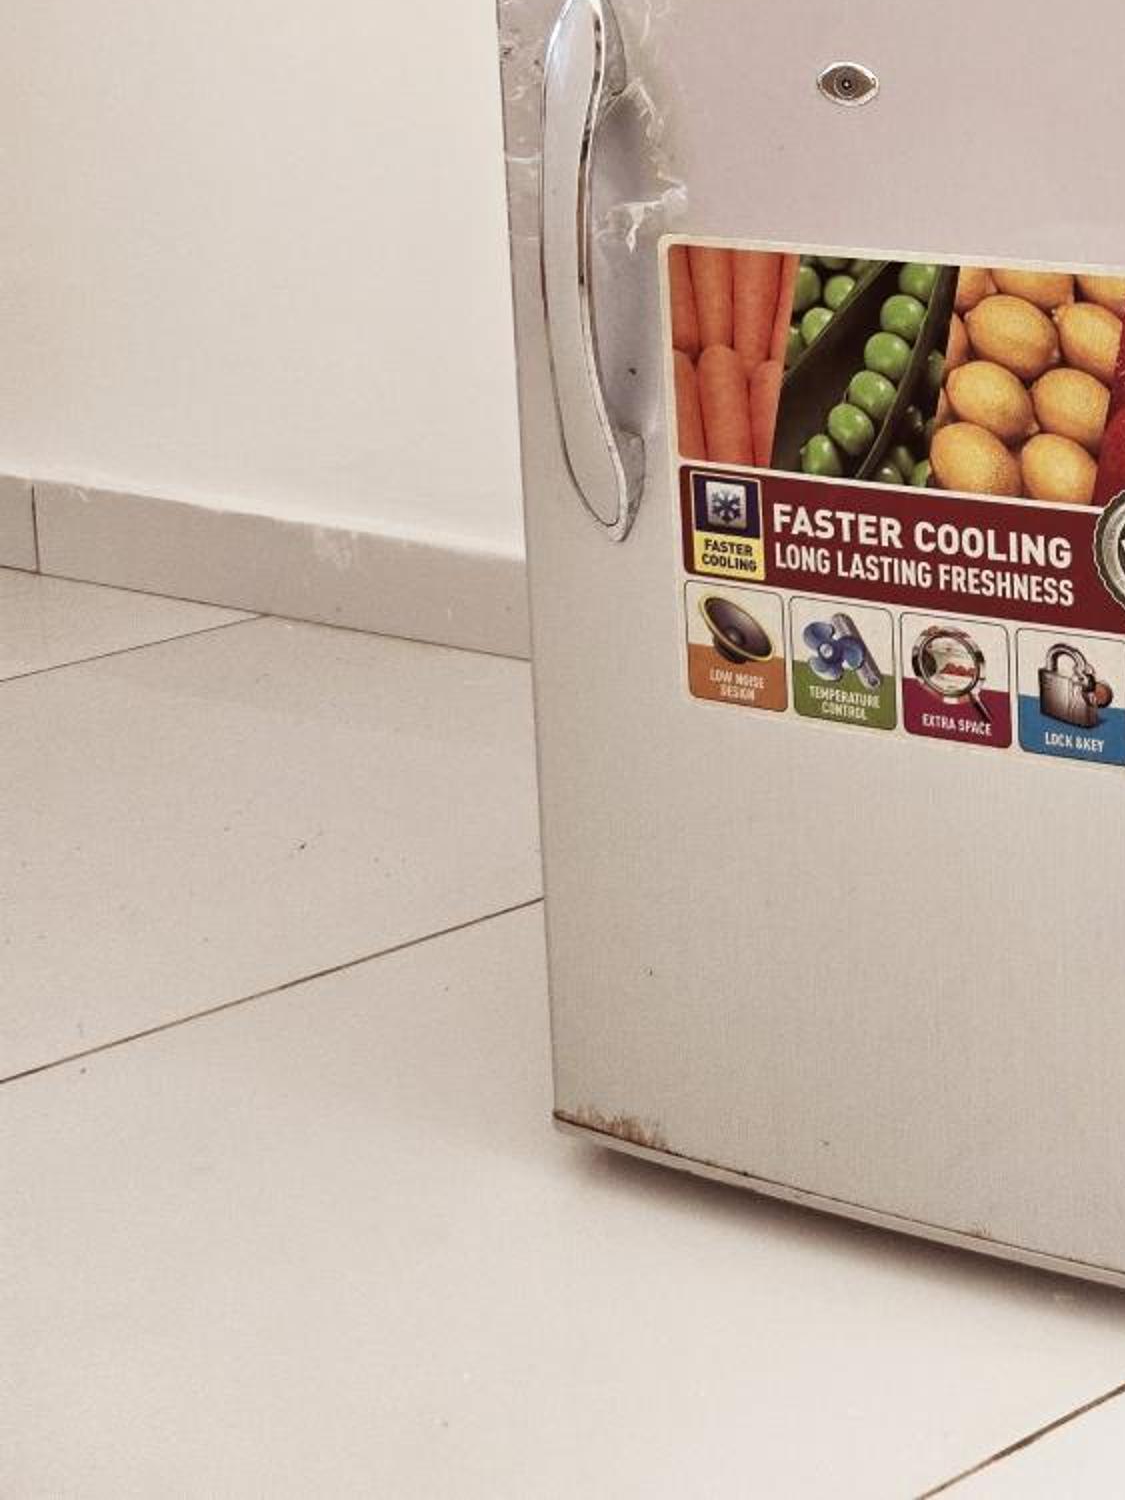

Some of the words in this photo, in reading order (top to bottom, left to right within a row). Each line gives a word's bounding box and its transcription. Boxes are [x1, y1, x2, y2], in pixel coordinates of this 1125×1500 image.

[773, 503, 903, 549] FASTER
[914, 520, 1073, 569] COOLING
[704, 537, 754, 557] FASTER
[701, 552, 758, 573] COOLING
[775, 542, 831, 575] LONG
[837, 550, 932, 590] LASTING
[939, 565, 1074, 607] FRESHNESS
[709, 668, 733, 683] LOW
[734, 674, 766, 690] NOISE
[719, 684, 756, 701] DESIGN
[809, 685, 882, 710] TEMPERATURE
[821, 701, 868, 721] CONTROL
[921, 713, 955, 731] EXTRA
[957, 718, 993, 737] SPACE
[1044, 731, 1073, 749] LOCK
